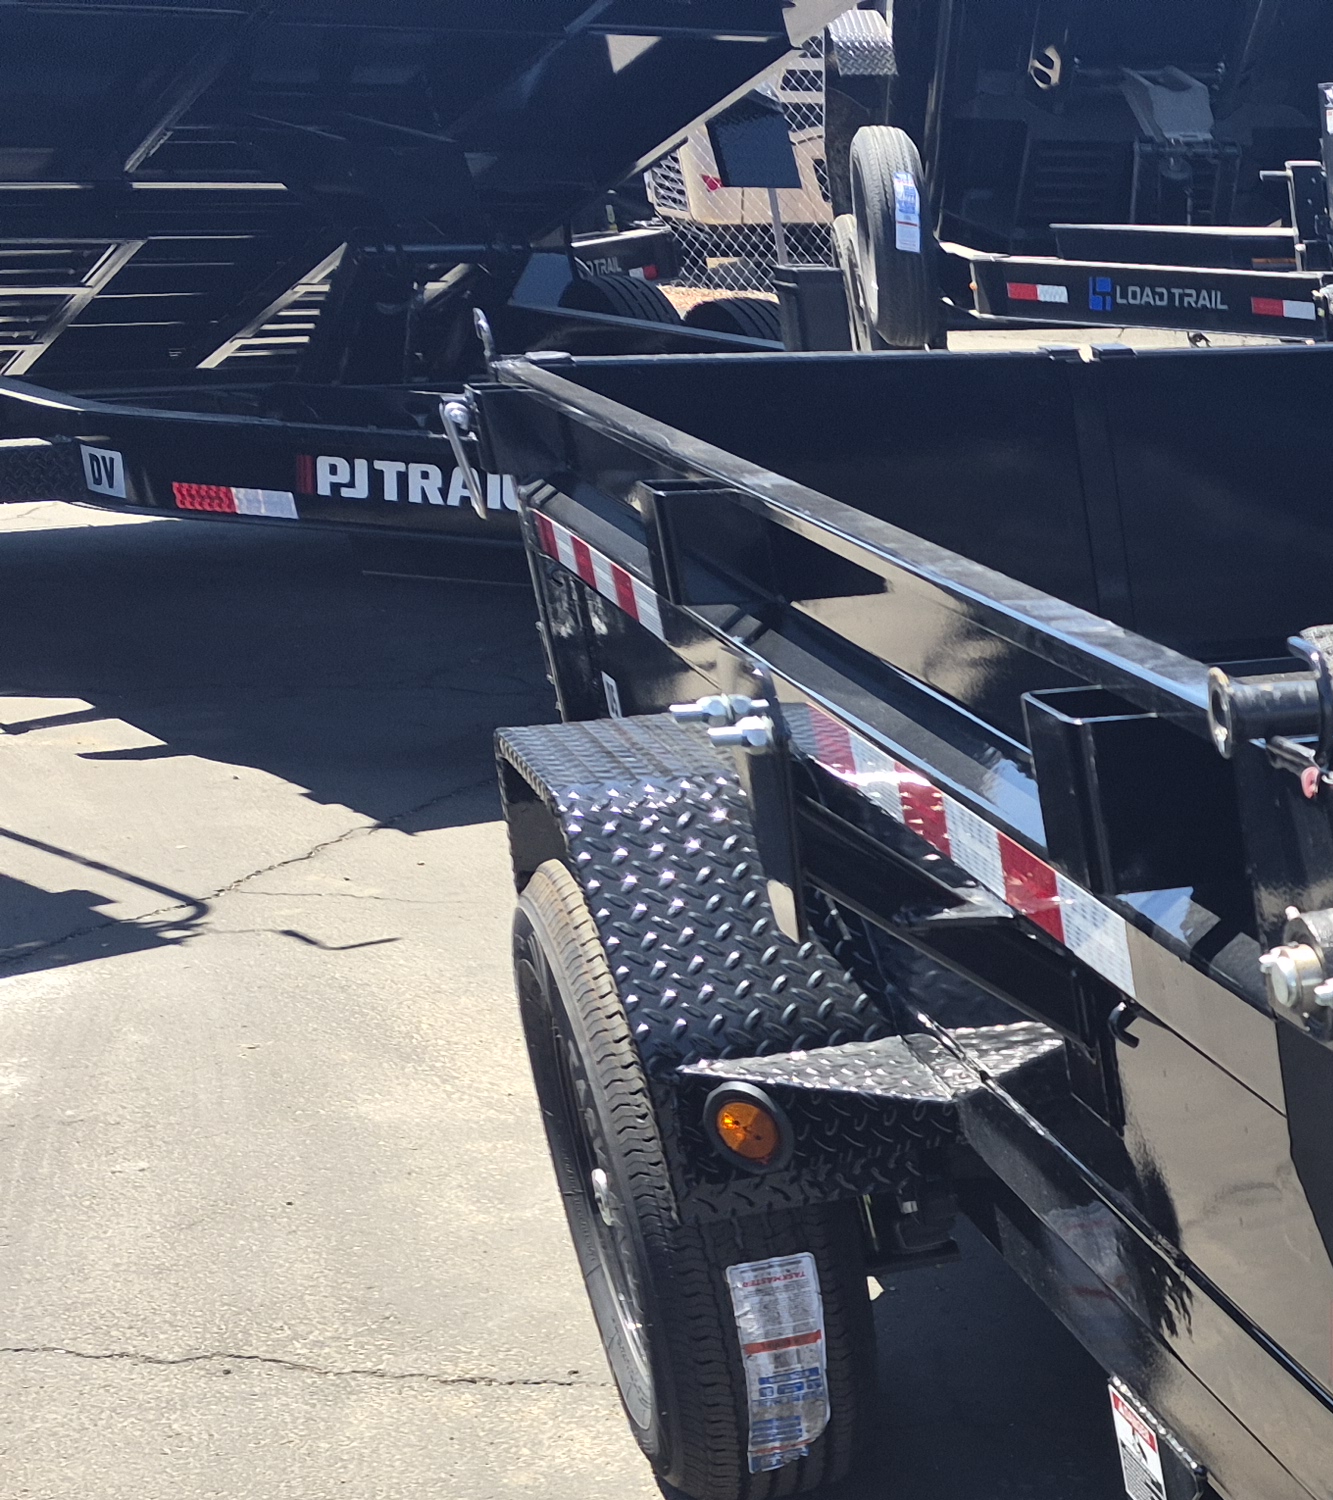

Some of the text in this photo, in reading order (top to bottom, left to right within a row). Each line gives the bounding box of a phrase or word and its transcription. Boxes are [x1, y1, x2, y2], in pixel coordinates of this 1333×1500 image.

[1116, 285, 1229, 310] LOAD TRAIL
[89, 452, 115, 487] DV
[316, 455, 518, 511] PJ TRAIL
